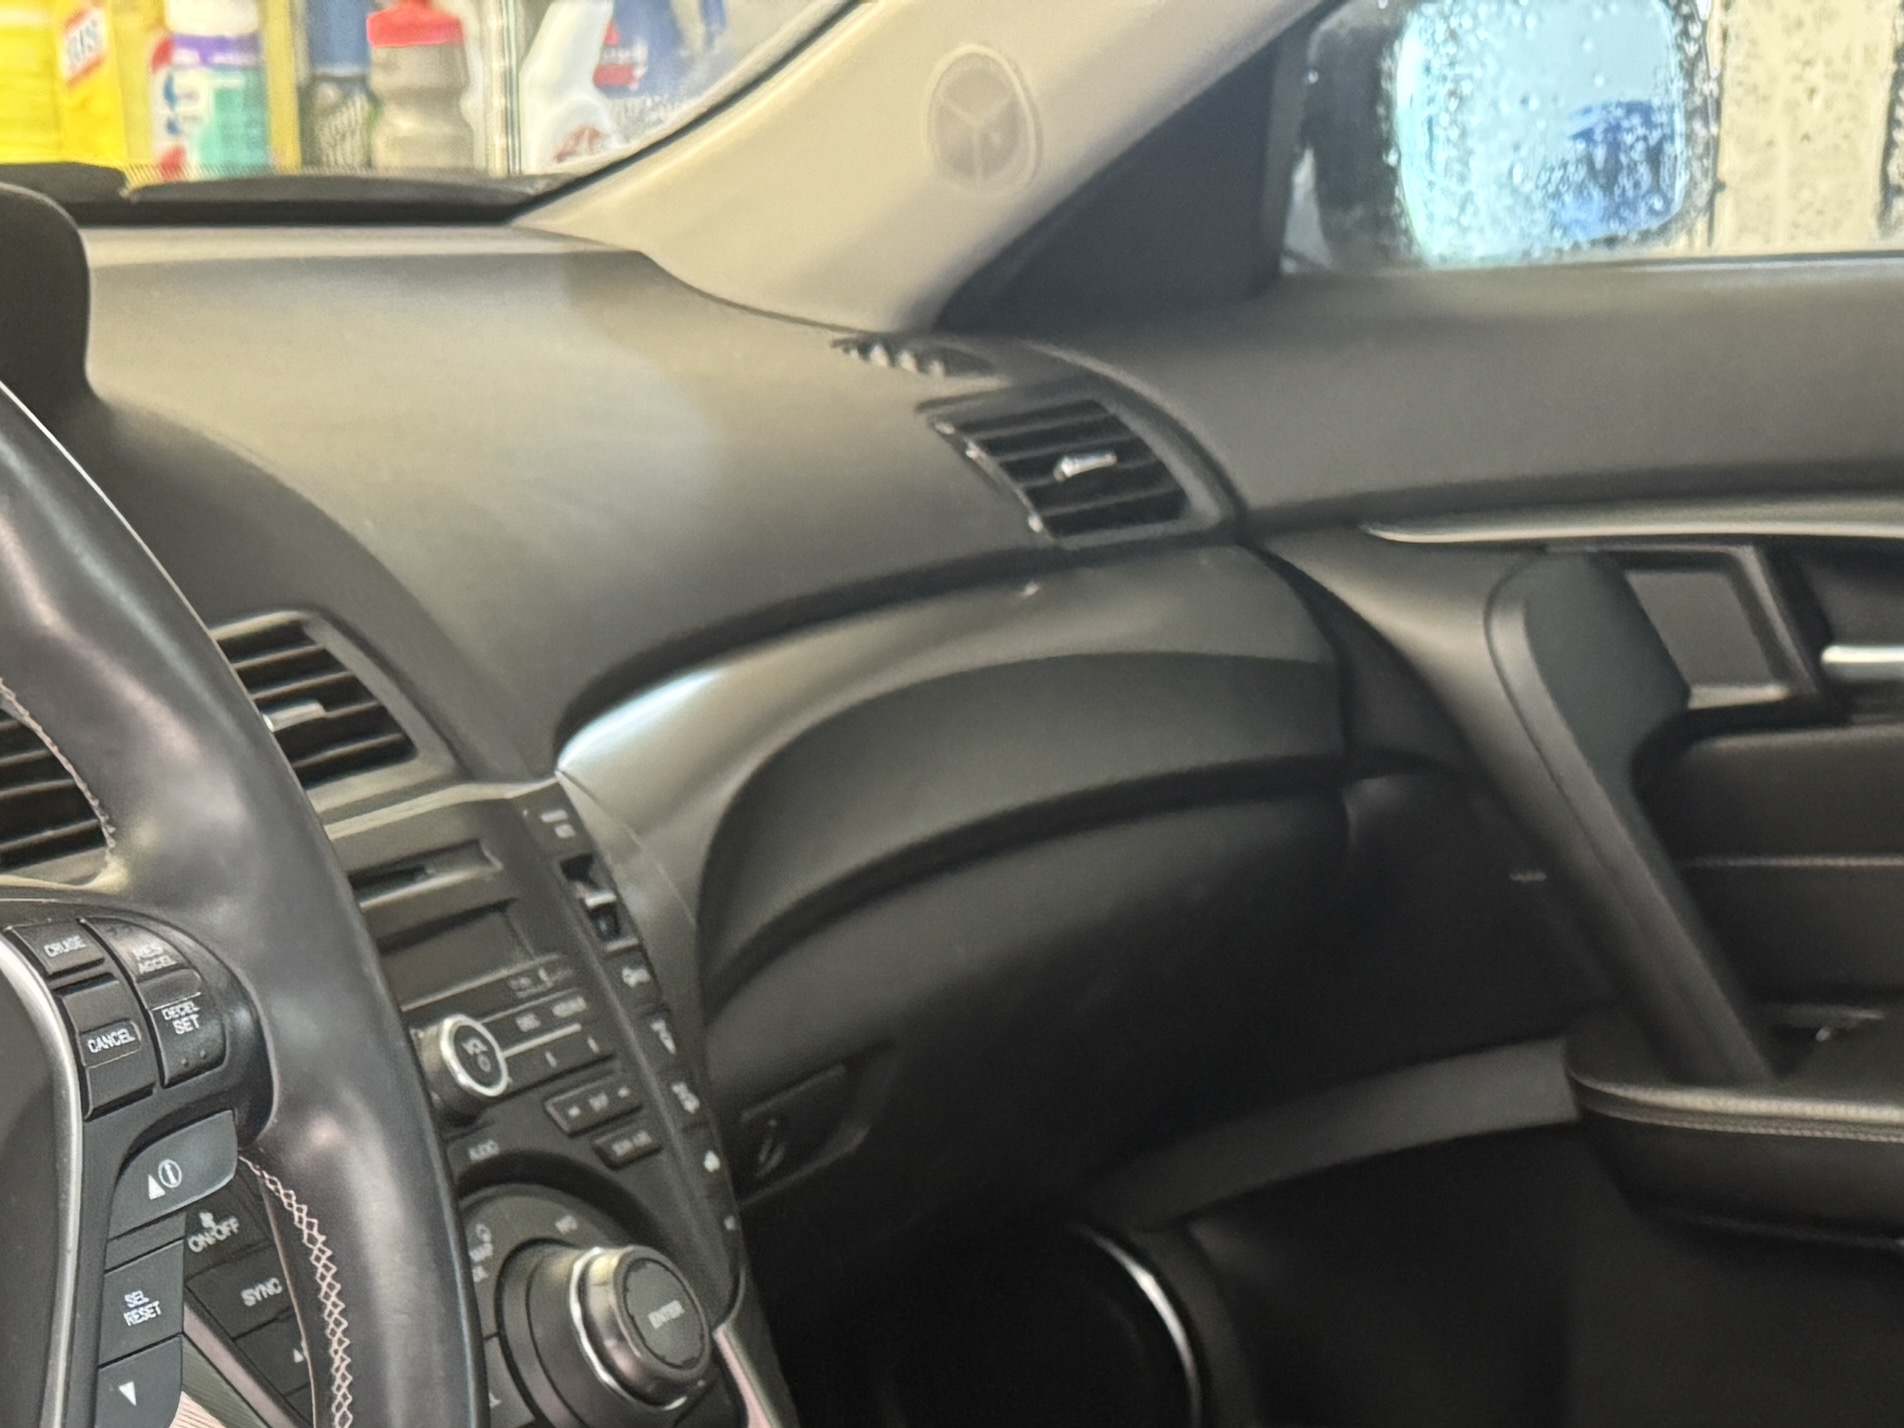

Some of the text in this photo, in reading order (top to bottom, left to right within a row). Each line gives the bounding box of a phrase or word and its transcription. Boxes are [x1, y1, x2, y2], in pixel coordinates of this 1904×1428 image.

[172, 1014, 200, 1035] SET
[87, 1028, 136, 1053] CANCEL
[124, 1290, 150, 1308] SEL
[240, 1277, 283, 1307] SYNC
[123, 1301, 162, 1327] RESET
